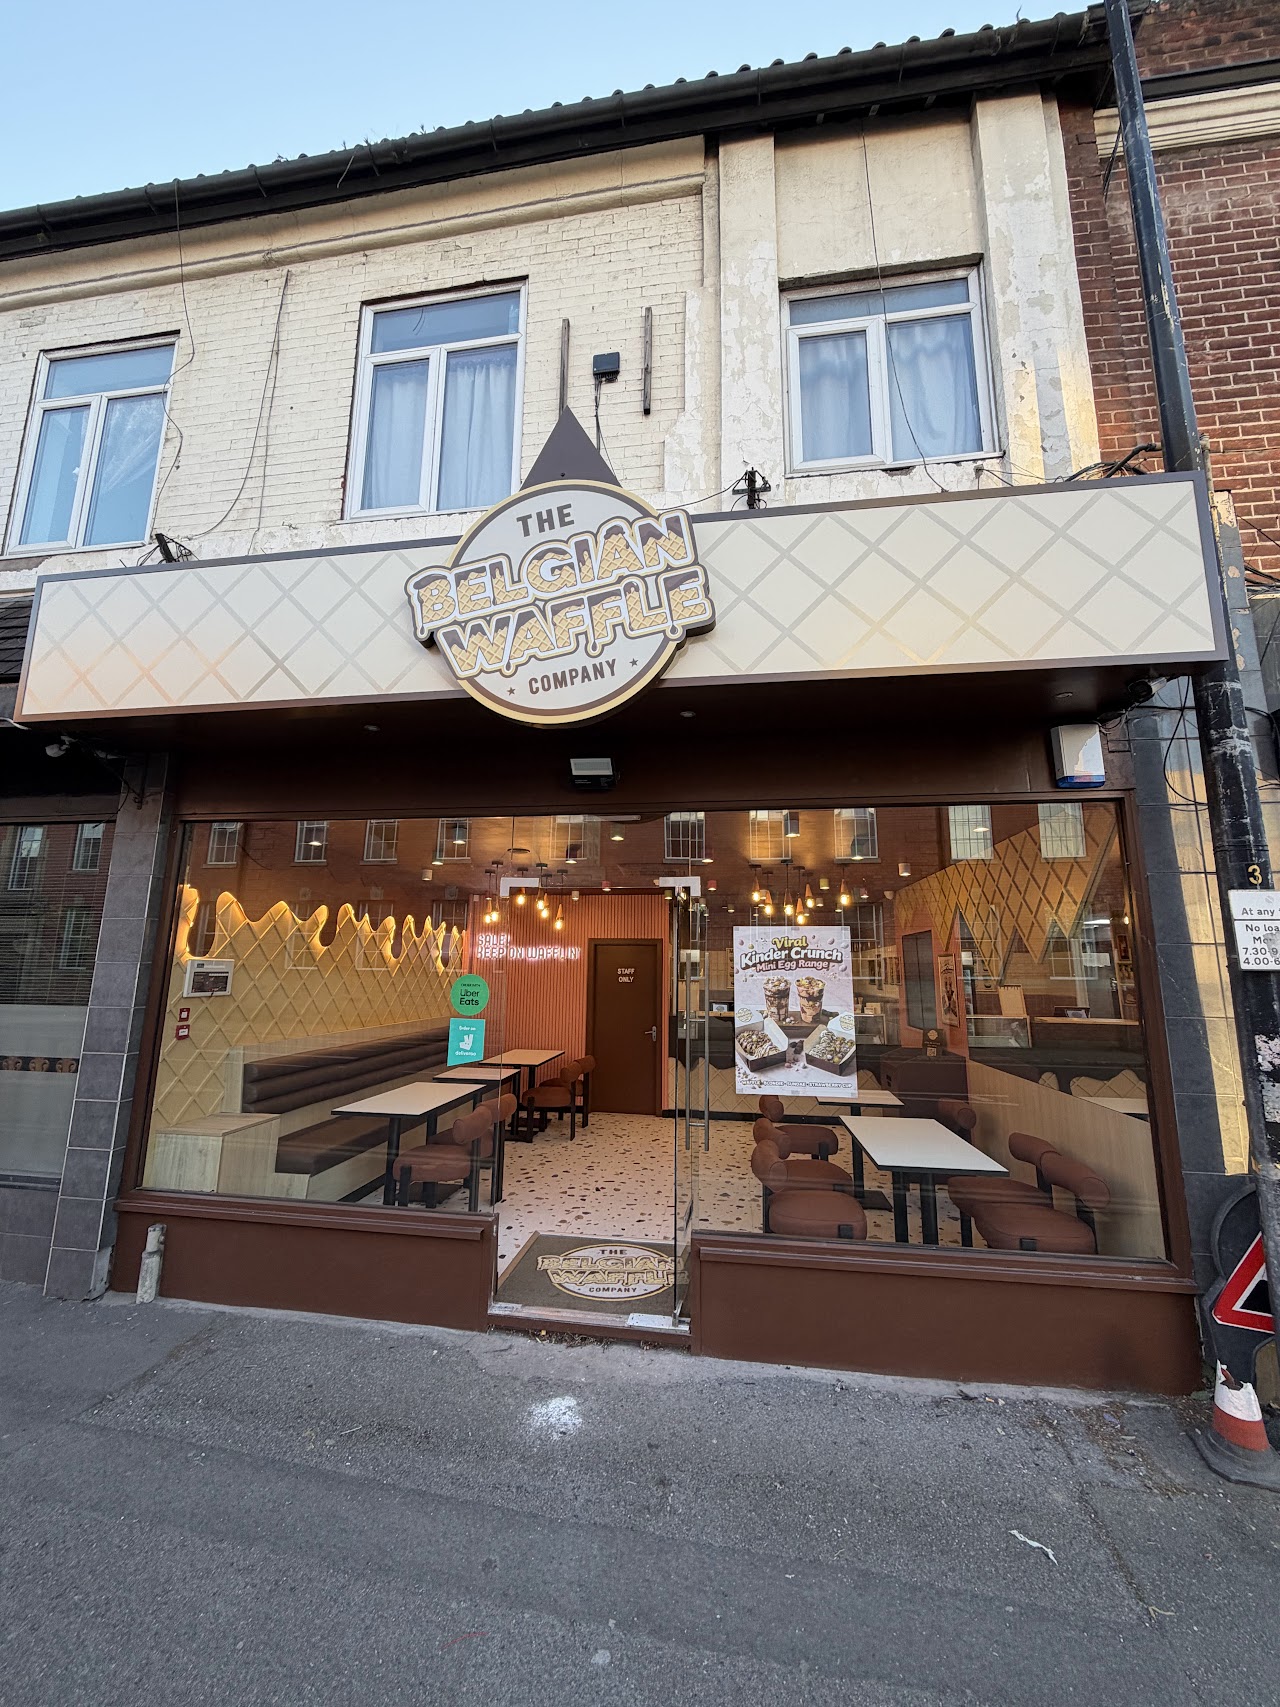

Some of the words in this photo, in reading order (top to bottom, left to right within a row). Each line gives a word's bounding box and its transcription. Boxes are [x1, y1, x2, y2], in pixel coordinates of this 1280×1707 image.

[516, 503, 575, 537] THE
[411, 514, 690, 627] BELGIAN
[438, 569, 707, 672] WAFFLE
[528, 658, 617, 695] COMPANY
[1247, 864, 1263, 885] 3
[1241, 907, 1254, 916] At
[1256, 909, 1275, 917] any
[1245, 923, 1261, 932] No
[771, 935, 808, 949] Viral
[476, 946, 507, 959] KEEP
[508, 946, 524, 959] ON
[740, 948, 789, 969] Kinder
[790, 947, 843, 962] Crunch
[755, 961, 777, 973] Mini
[777, 960, 797, 971] Egg
[798, 959, 829, 971] Range
[460, 988, 480, 998] Uber
[459, 997, 480, 1006] Eats
